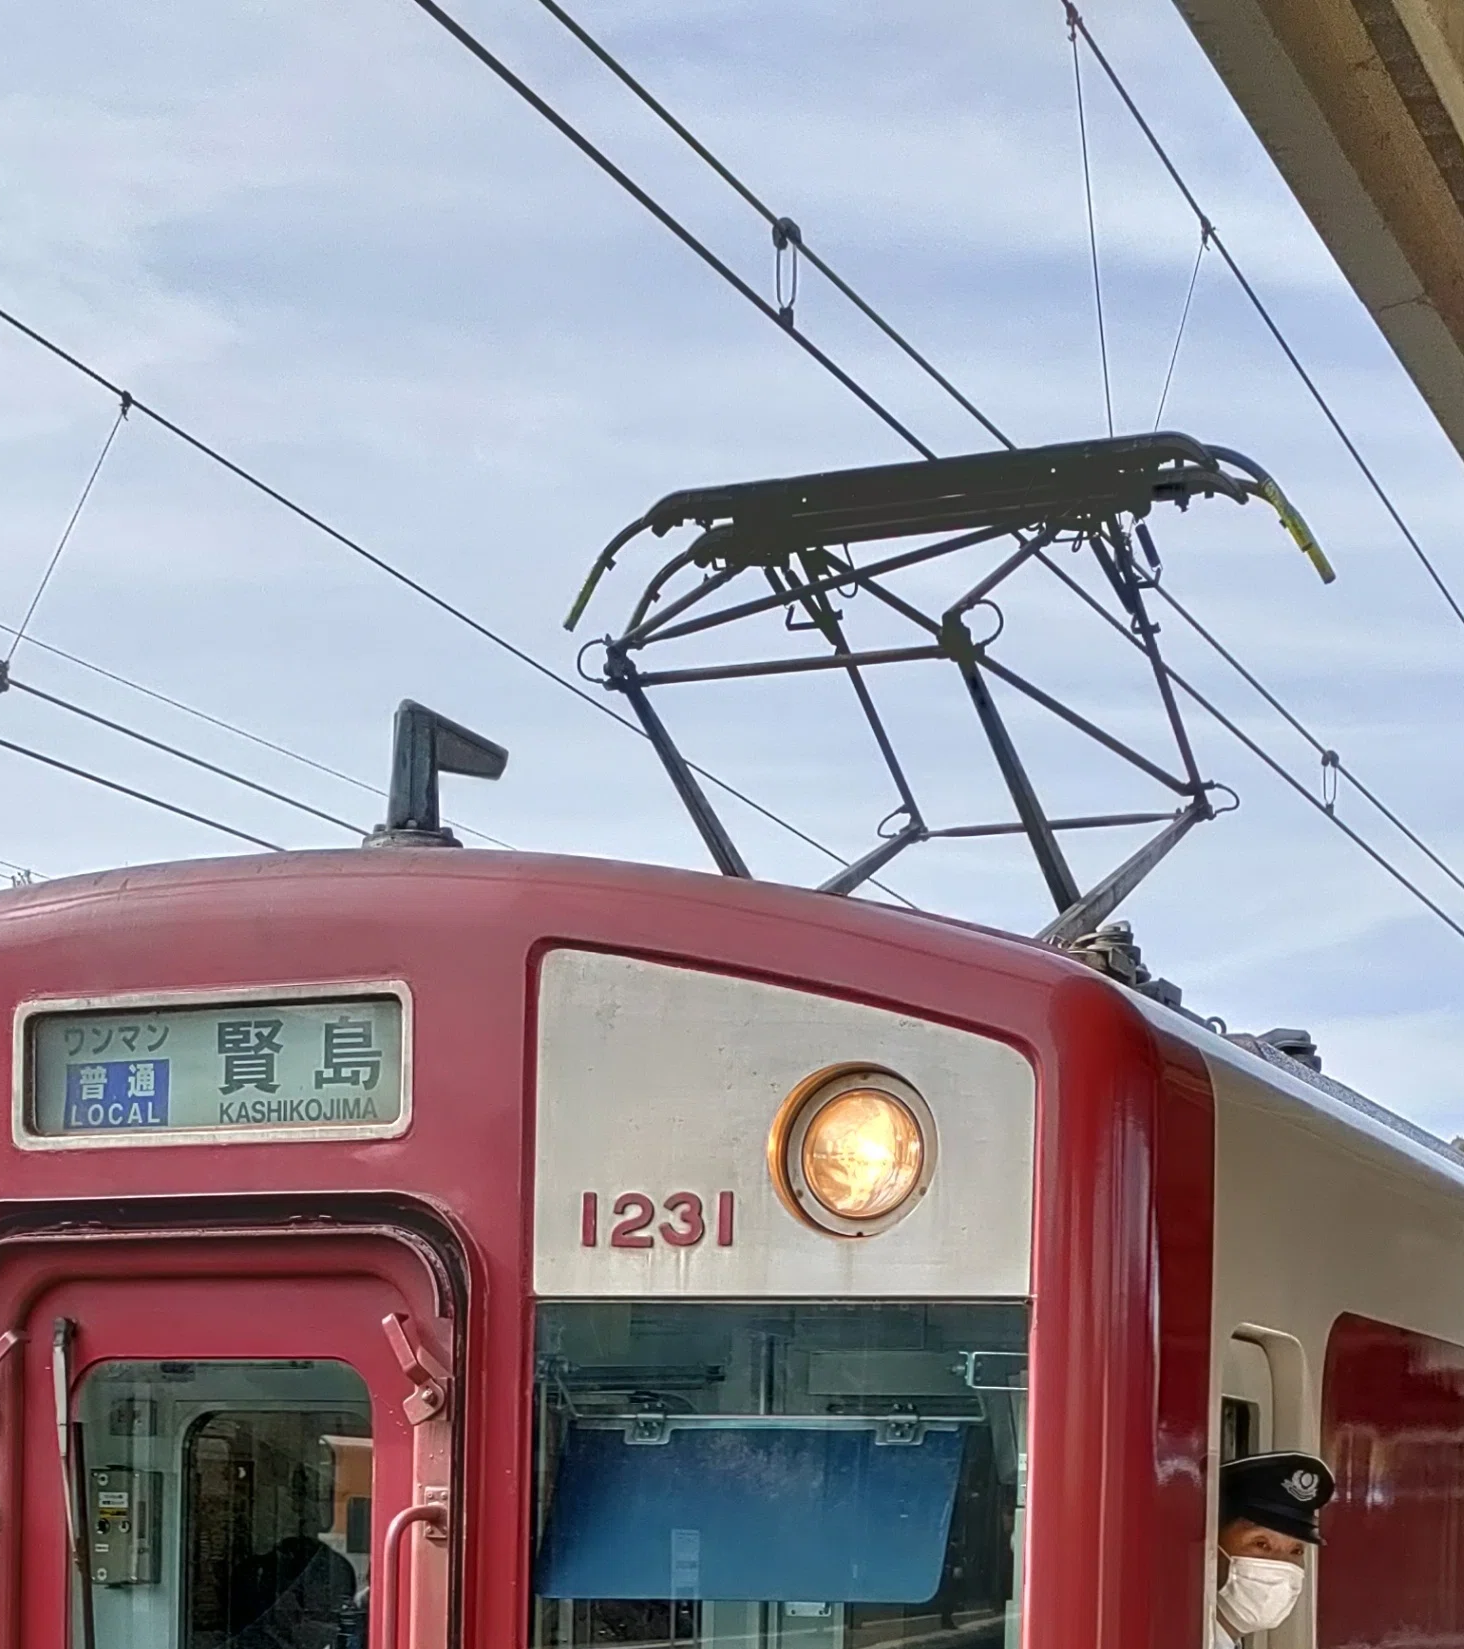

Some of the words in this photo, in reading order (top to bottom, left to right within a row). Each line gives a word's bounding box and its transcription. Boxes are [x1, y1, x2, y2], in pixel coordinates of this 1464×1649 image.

[64, 1023, 170, 1057] ワンマン
[216, 1015, 383, 1095] 賢島
[79, 1063, 157, 1100] 普通
[71, 1102, 161, 1127] LOCAL
[219, 1097, 378, 1124] KASHIKOJIMA
[581, 1190, 734, 1248] 1231
